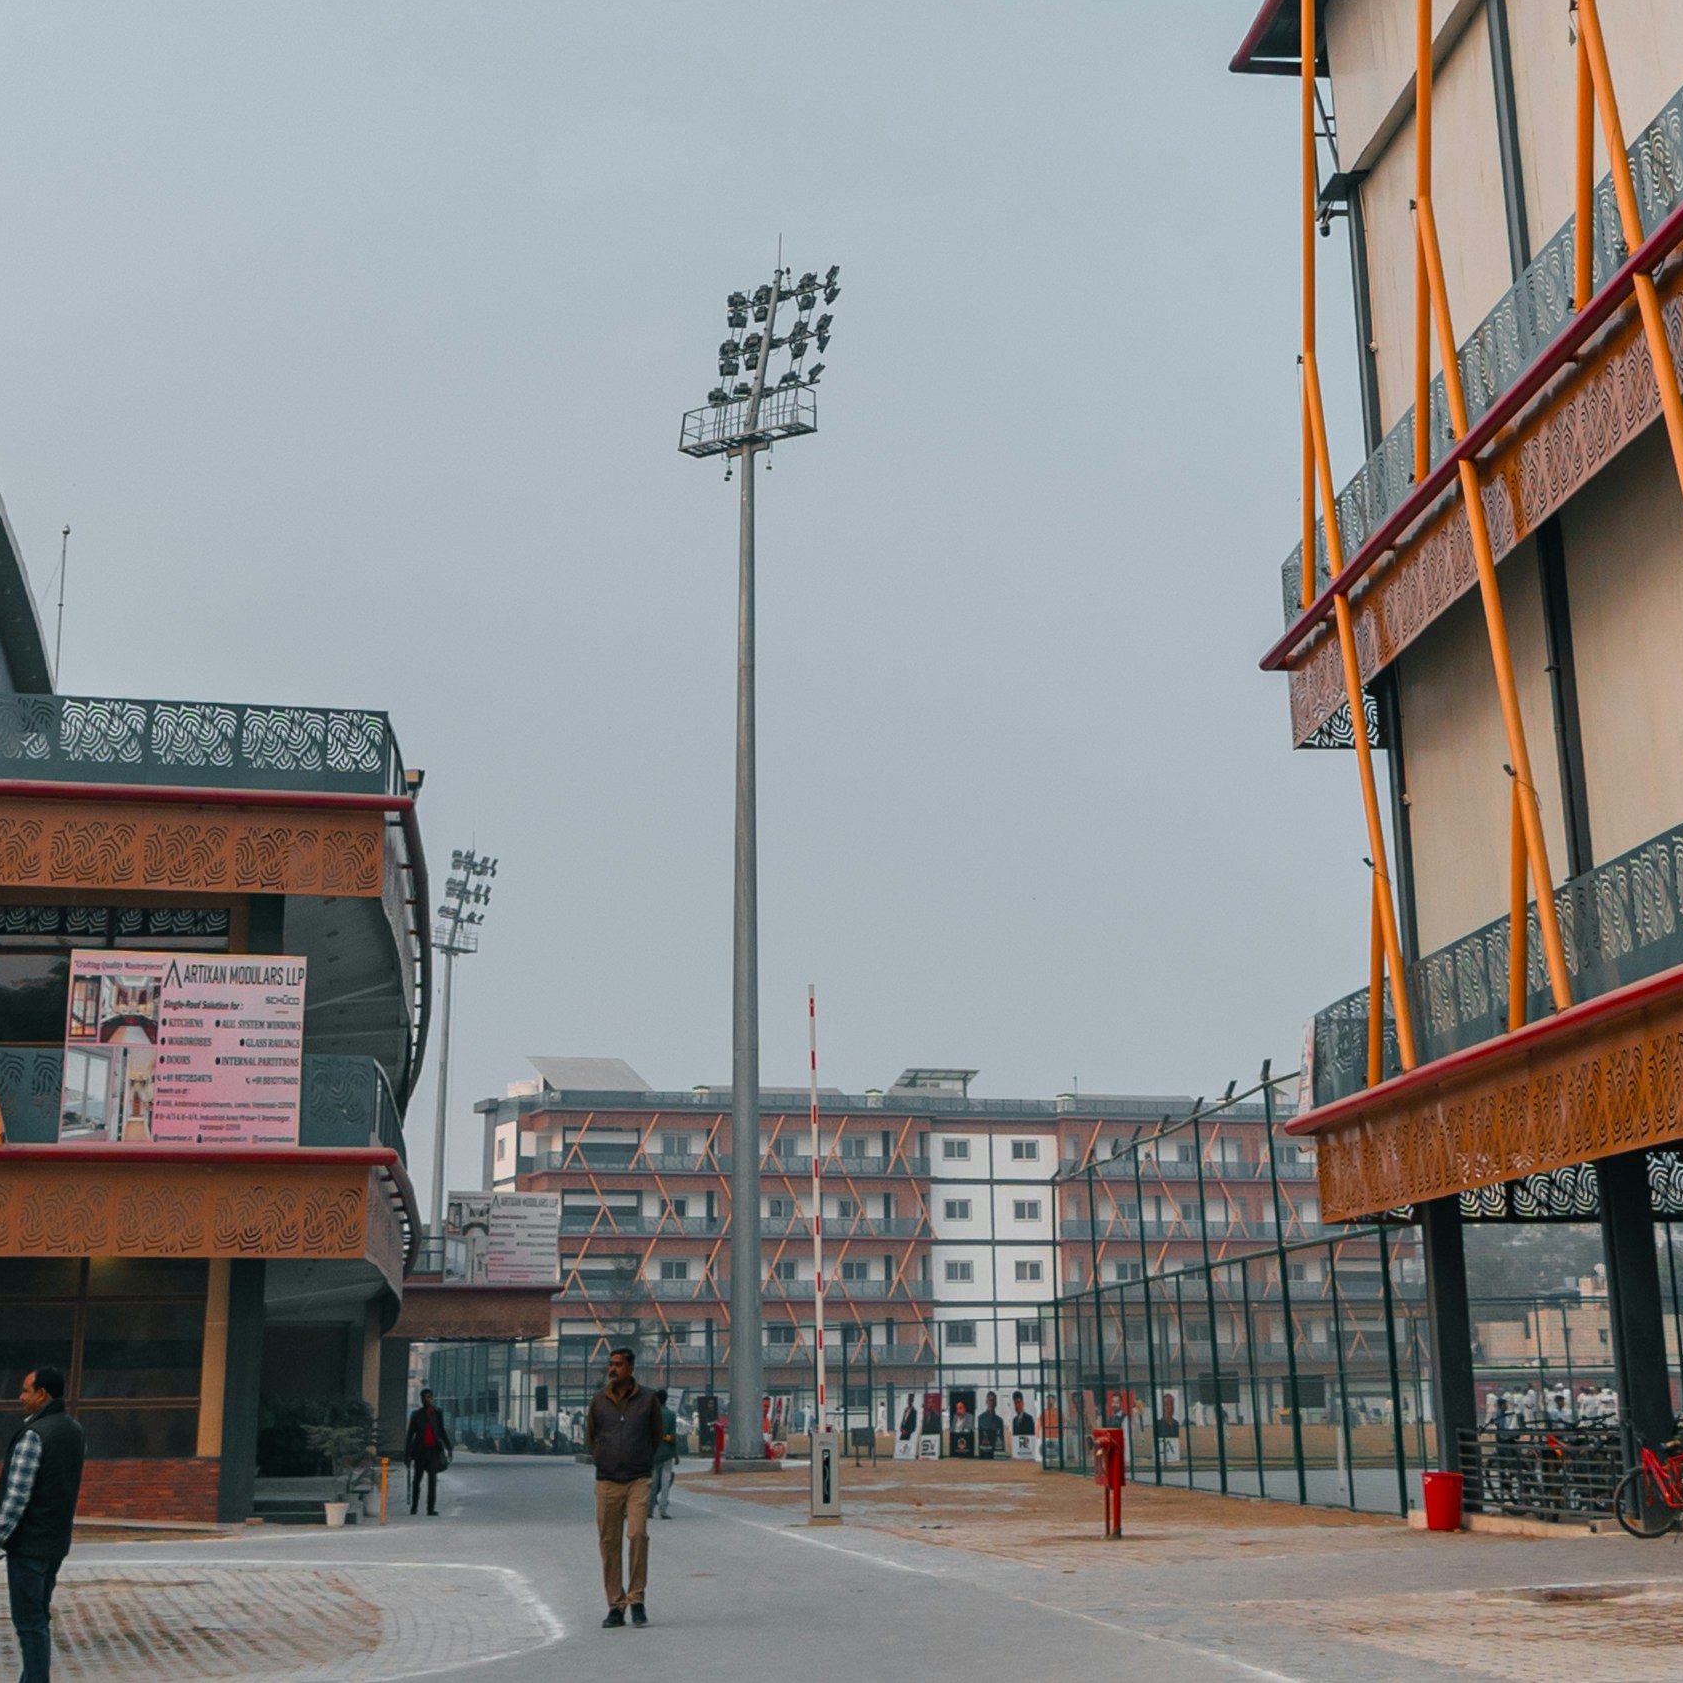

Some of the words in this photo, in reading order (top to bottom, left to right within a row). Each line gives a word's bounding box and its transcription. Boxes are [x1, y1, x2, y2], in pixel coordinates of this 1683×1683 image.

[183, 964, 226, 985] ARTIXAN
[229, 965, 284, 986] MODULARS
[285, 967, 305, 987] LLP
